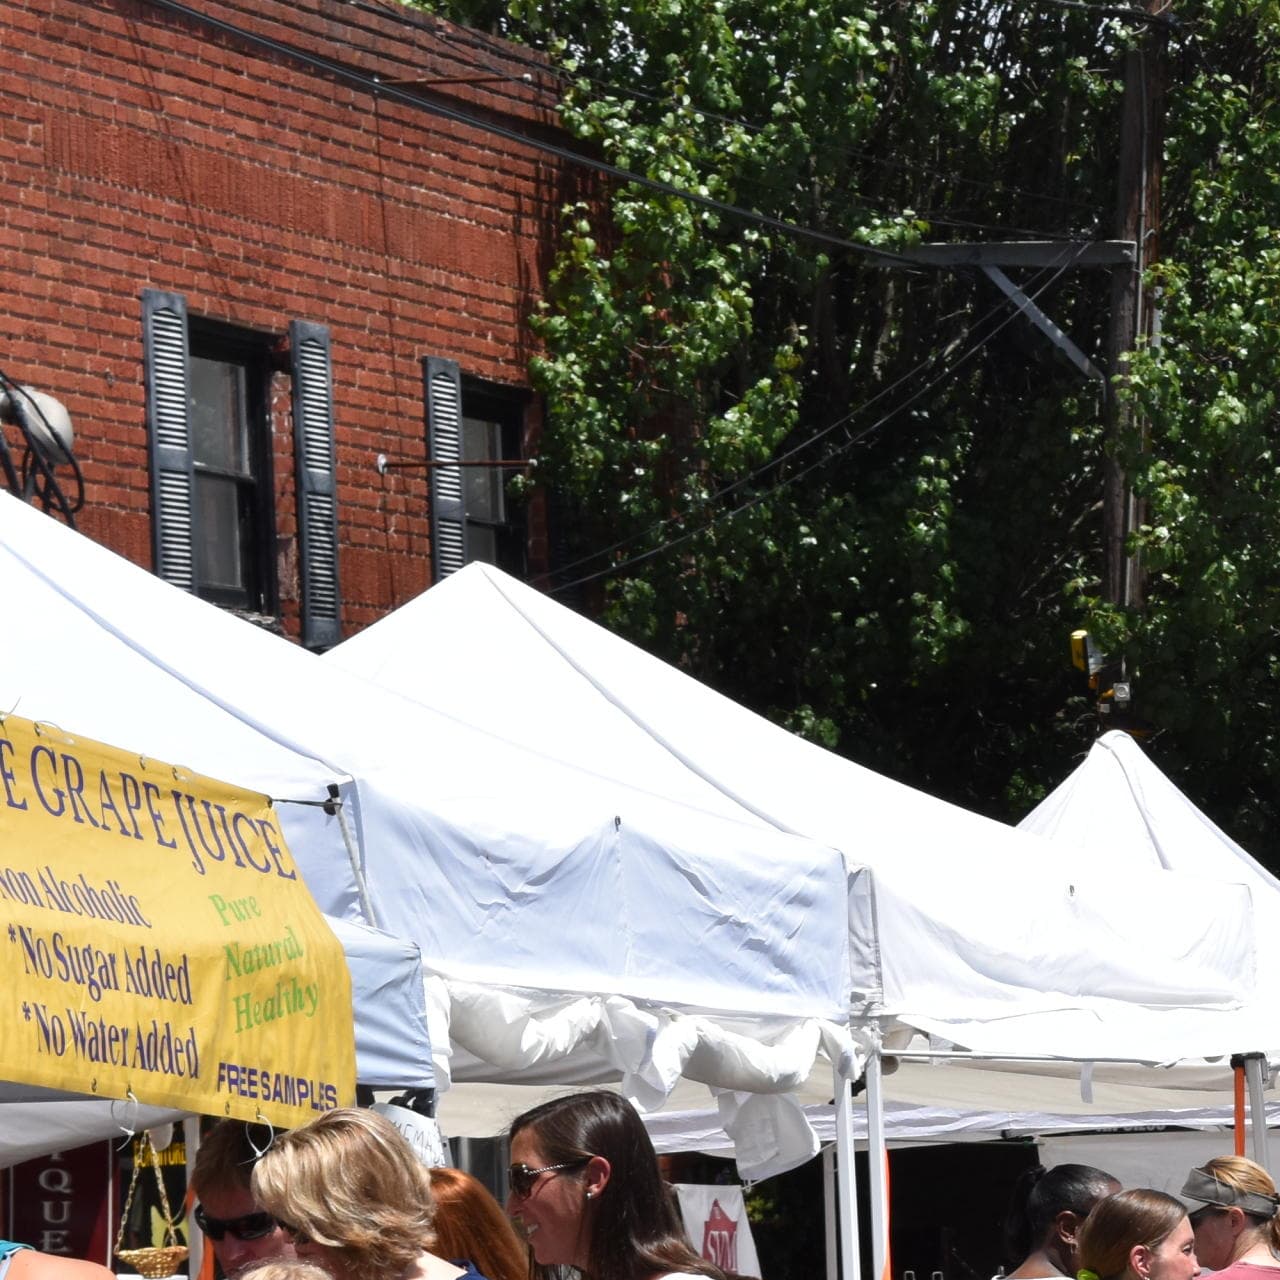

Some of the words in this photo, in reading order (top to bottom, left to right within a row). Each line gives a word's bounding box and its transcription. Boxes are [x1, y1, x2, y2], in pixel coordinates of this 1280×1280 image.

[30, 744, 177, 850] GRAPE
[173, 789, 297, 880] JUICE
[40, 866, 152, 929] Alcoholic
[209, 893, 262, 926] Pure
[52, 931, 118, 1002] Sugar
[124, 947, 193, 1005] Added
[223, 926, 305, 982] Natural
[233, 978, 321, 1034] Healthy
[65, 1008, 129, 1064] Water
[132, 1020, 200, 1079] Added
[217, 1062, 259, 1099] FREE
[260, 1072, 338, 1111] SAMPLES
